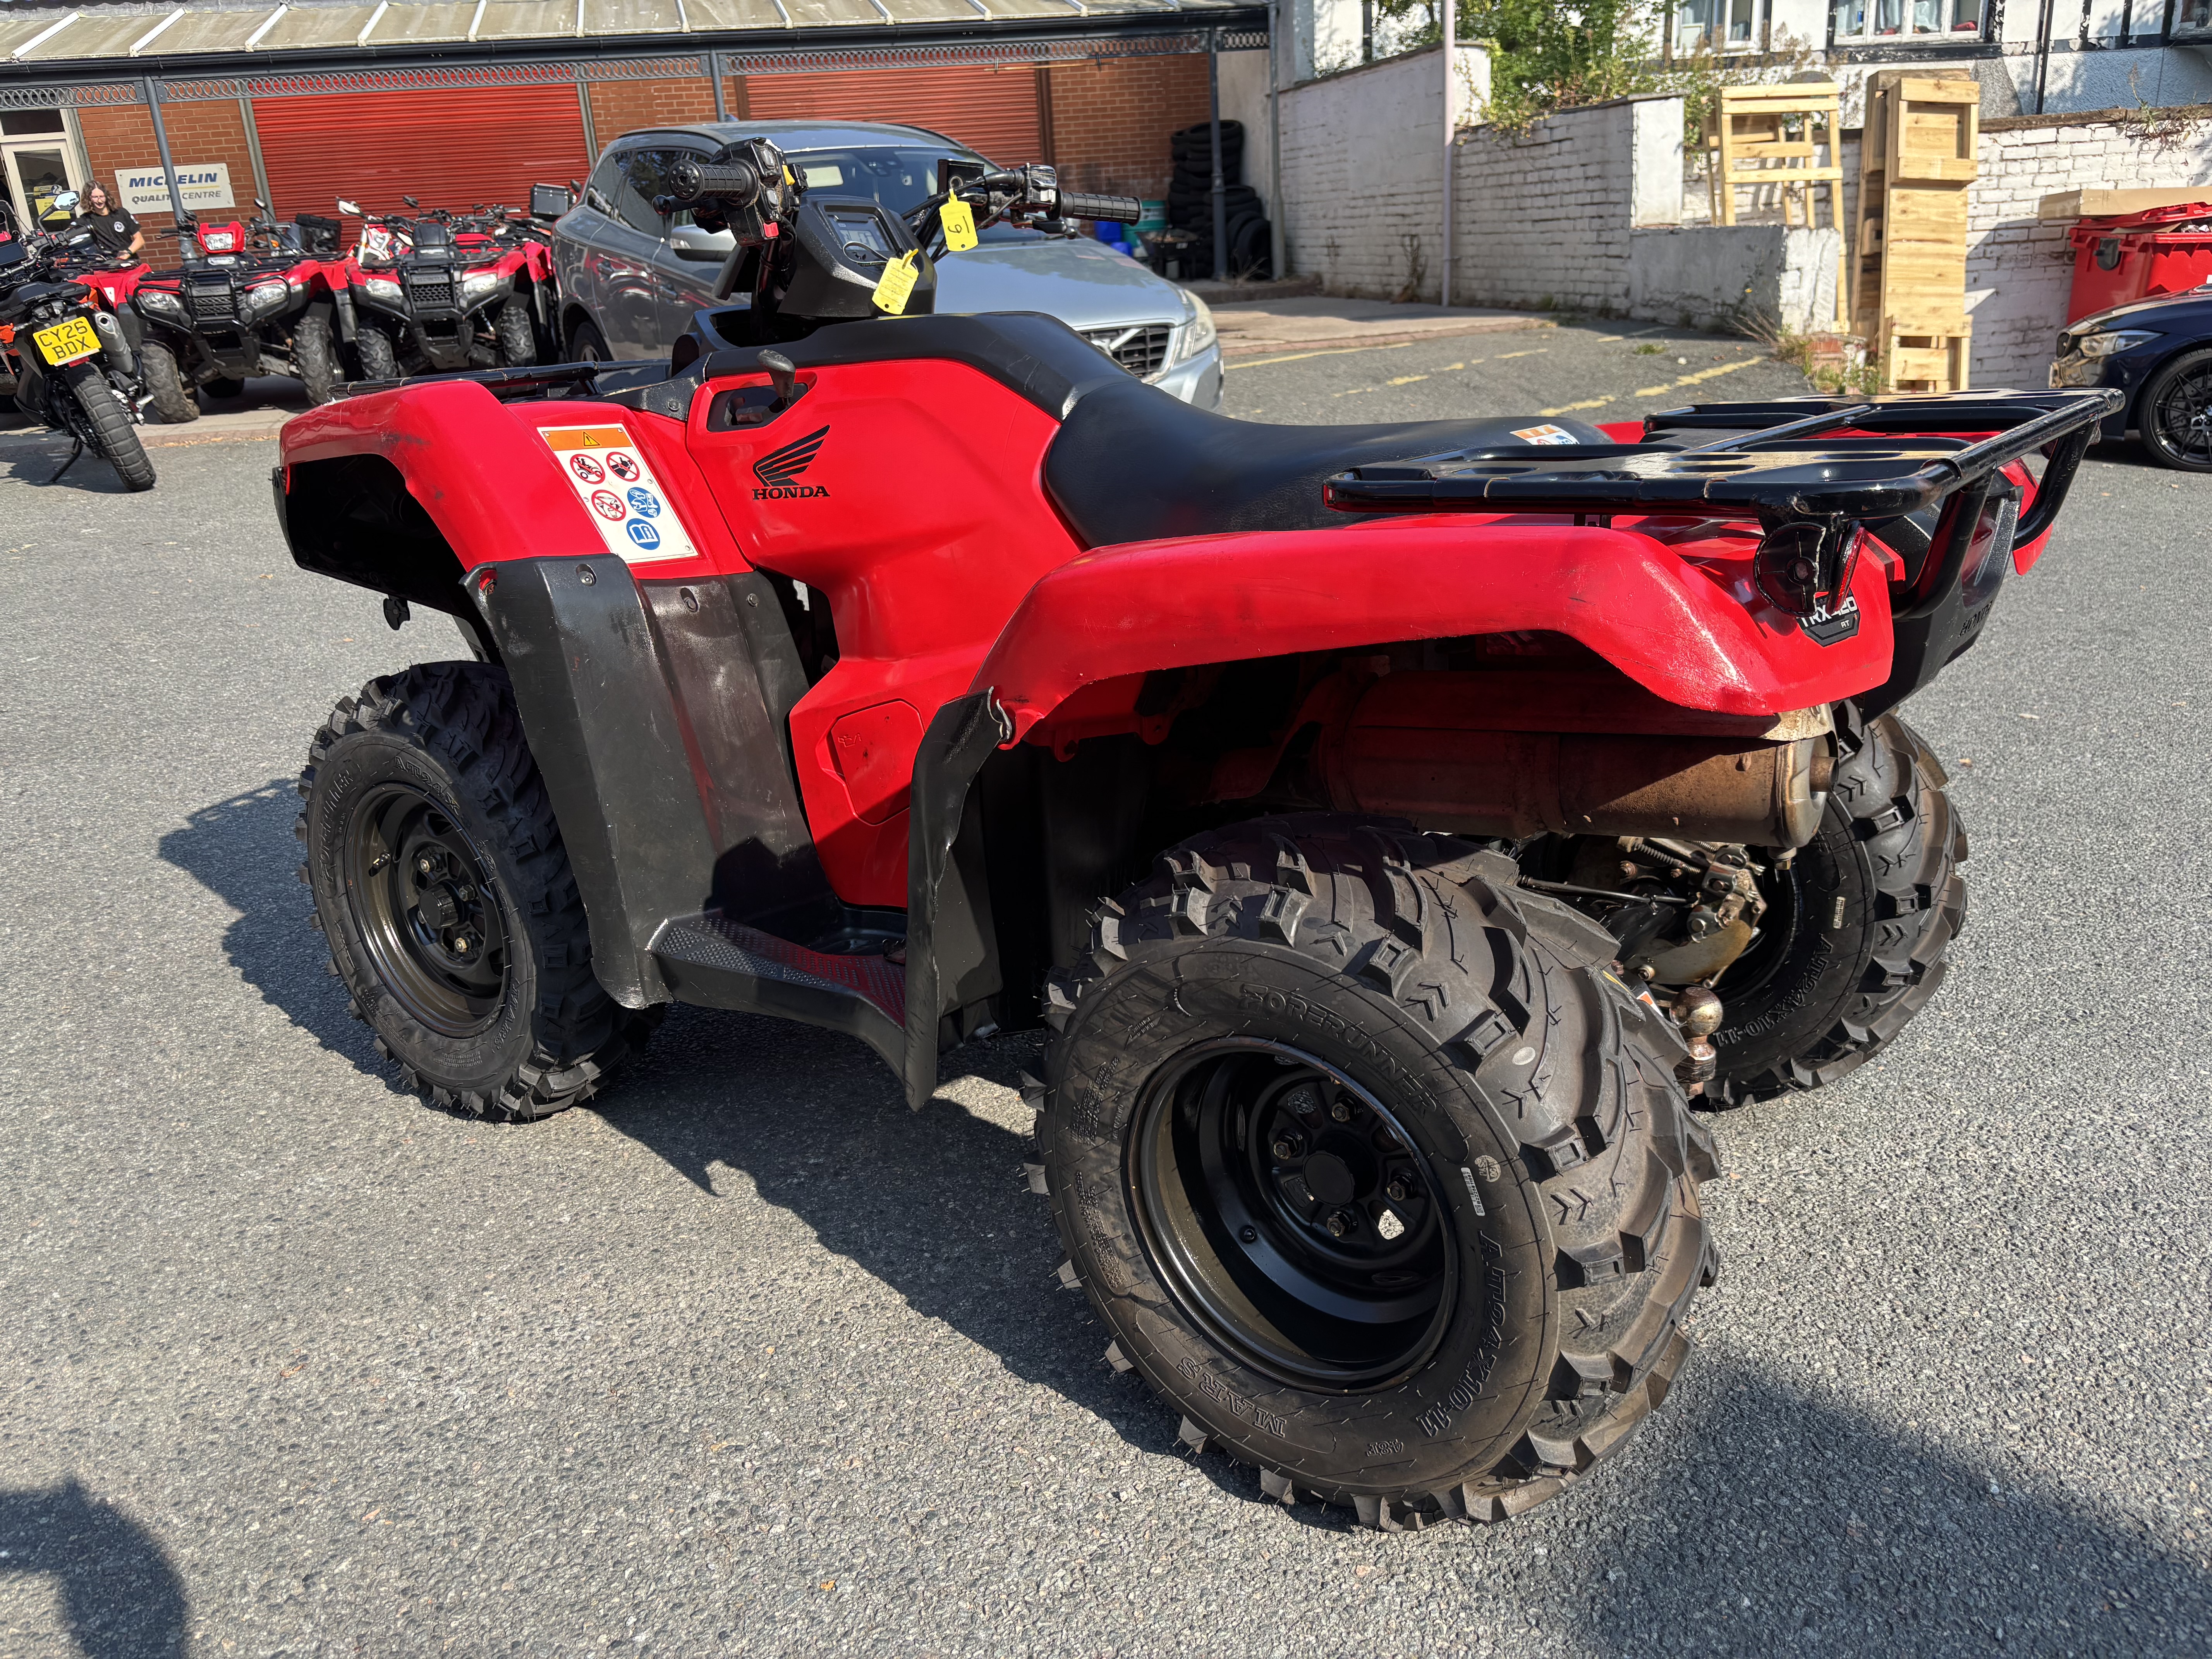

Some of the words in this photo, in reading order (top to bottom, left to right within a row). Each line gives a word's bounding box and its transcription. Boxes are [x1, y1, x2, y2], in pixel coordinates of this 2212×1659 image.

[129, 173, 217, 187] MICELIN
[132, 195, 171, 204] QUALIT
[182, 190, 222, 199] CENTRE
[38, 321, 88, 347] CY26
[52, 336, 91, 359] BDX
[752, 486, 831, 500] HONDA
[1958, 600, 1993, 638] HONDA
[1713, 933, 1834, 1047] AT24X10-11
[494, 984, 519, 1050] MARS
[1240, 983, 1437, 1118] FORERUNNER
[1416, 1230, 1506, 1437] AT24X10-11
[1176, 1357, 1287, 1438] MARS
